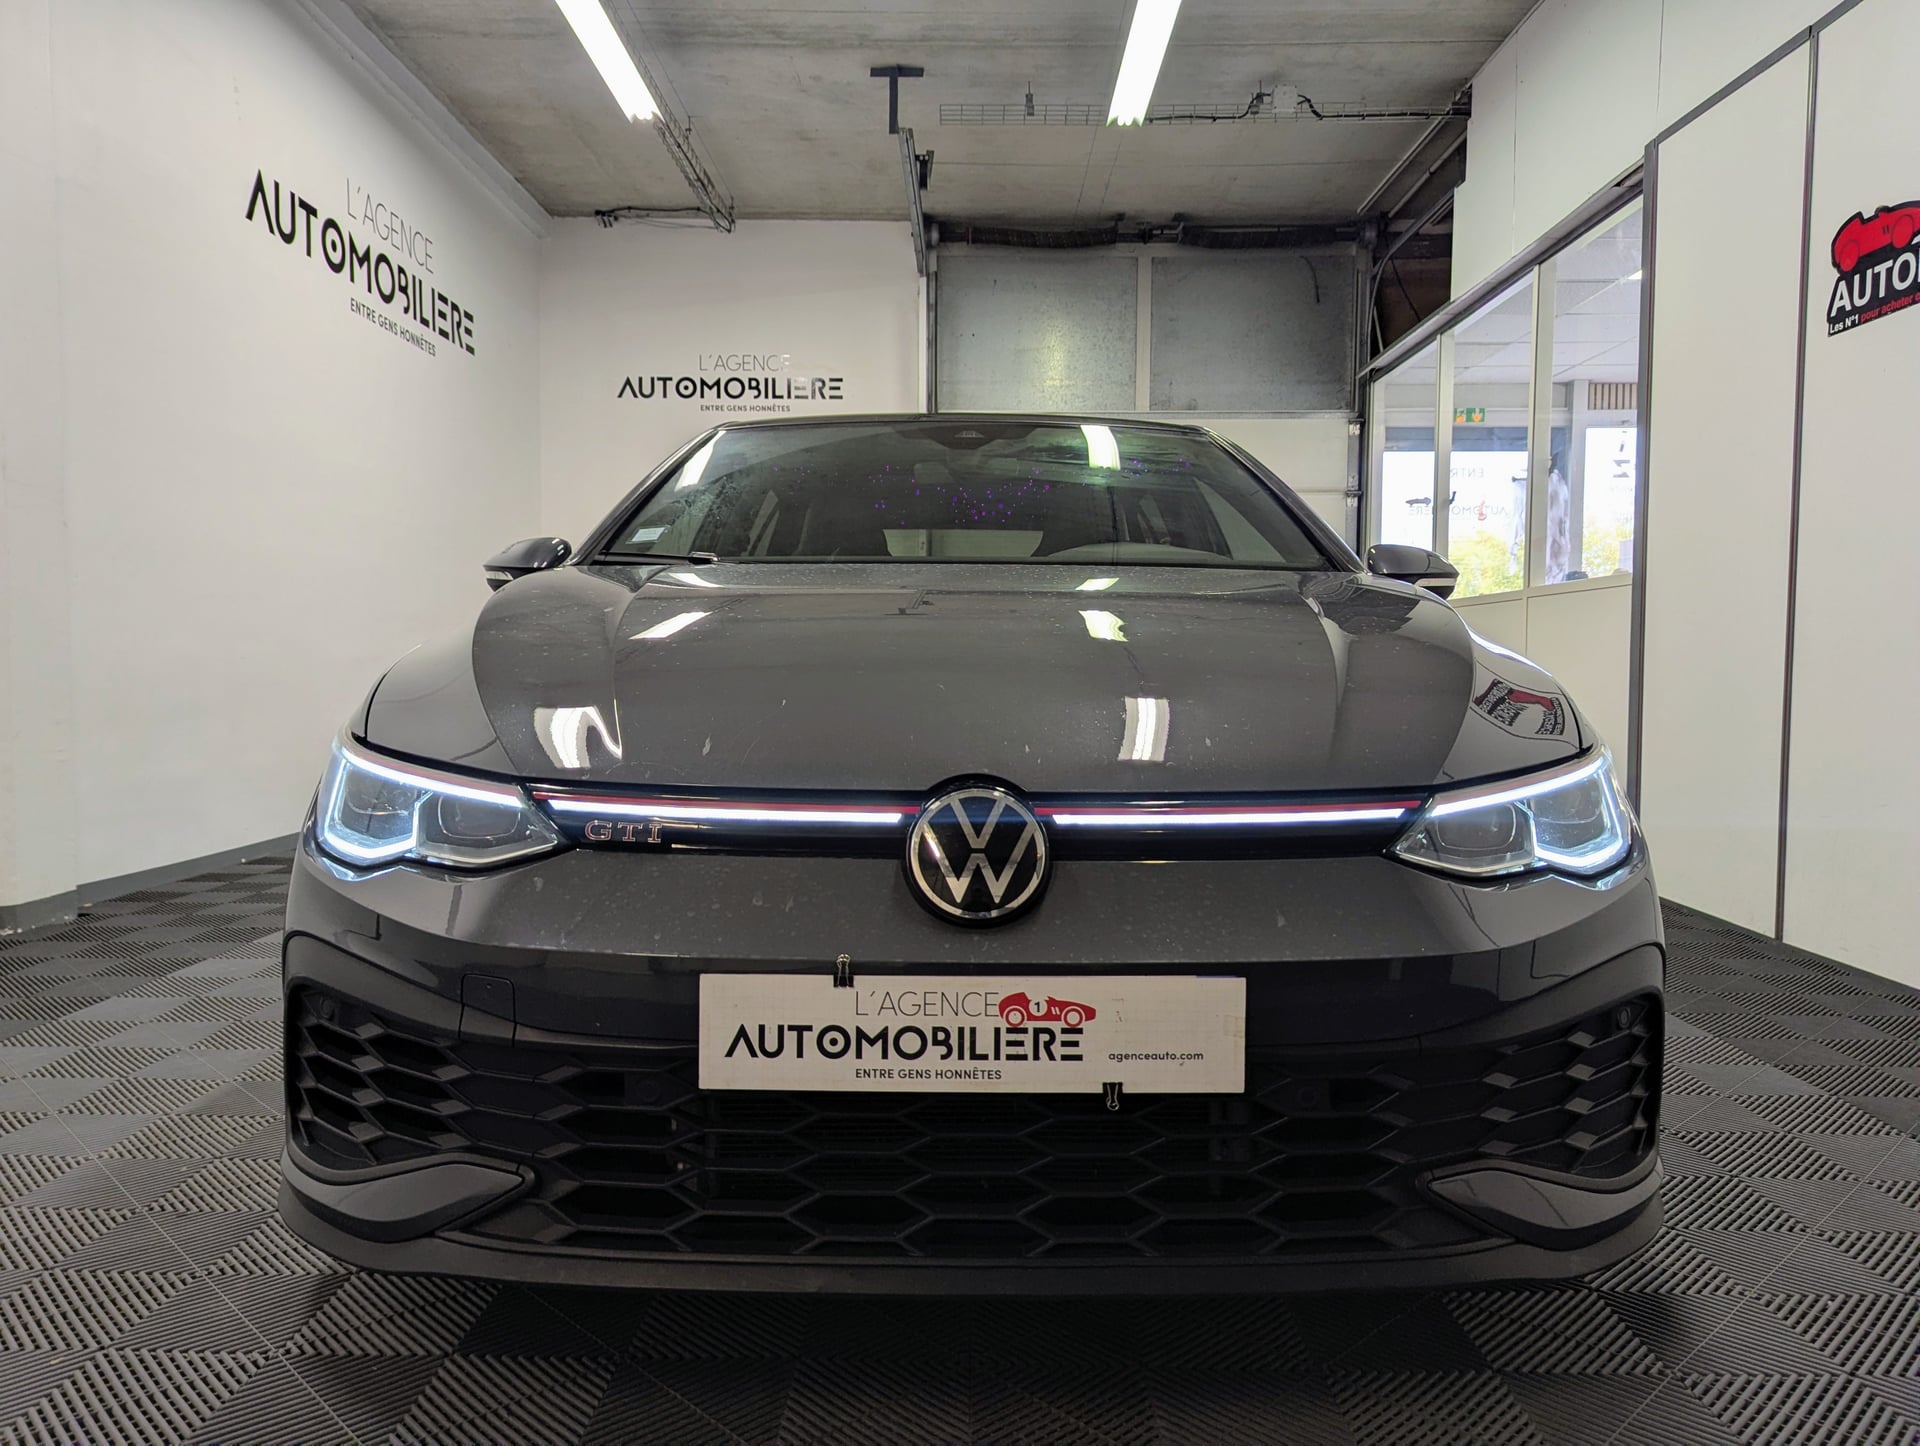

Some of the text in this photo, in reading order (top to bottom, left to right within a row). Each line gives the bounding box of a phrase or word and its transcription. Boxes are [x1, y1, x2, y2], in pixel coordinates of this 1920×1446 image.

[346, 177, 434, 275] L'AGENCE
[245, 168, 476, 357] AUTOMOBILIERE
[350, 297, 436, 357] ENTRE GENS HONNÊTES
[1829, 321, 1844, 334] Les
[1860, 308, 1880, 323] pour
[699, 353, 792, 372] L'AGENCE
[617, 376, 844, 400] AUTOMOBILIERE
[700, 402, 791, 412] ENTRE GENS HONNÊTES
[584, 819, 663, 844] GTI
[855, 990, 1000, 1017] L'AGENCE
[724, 1023, 1085, 1062] AUTOMOBILIERE
[1107, 1049, 1205, 1064] agenceauto.com
[854, 1064, 1002, 1080] ENTRE GENS HONNÊTES
